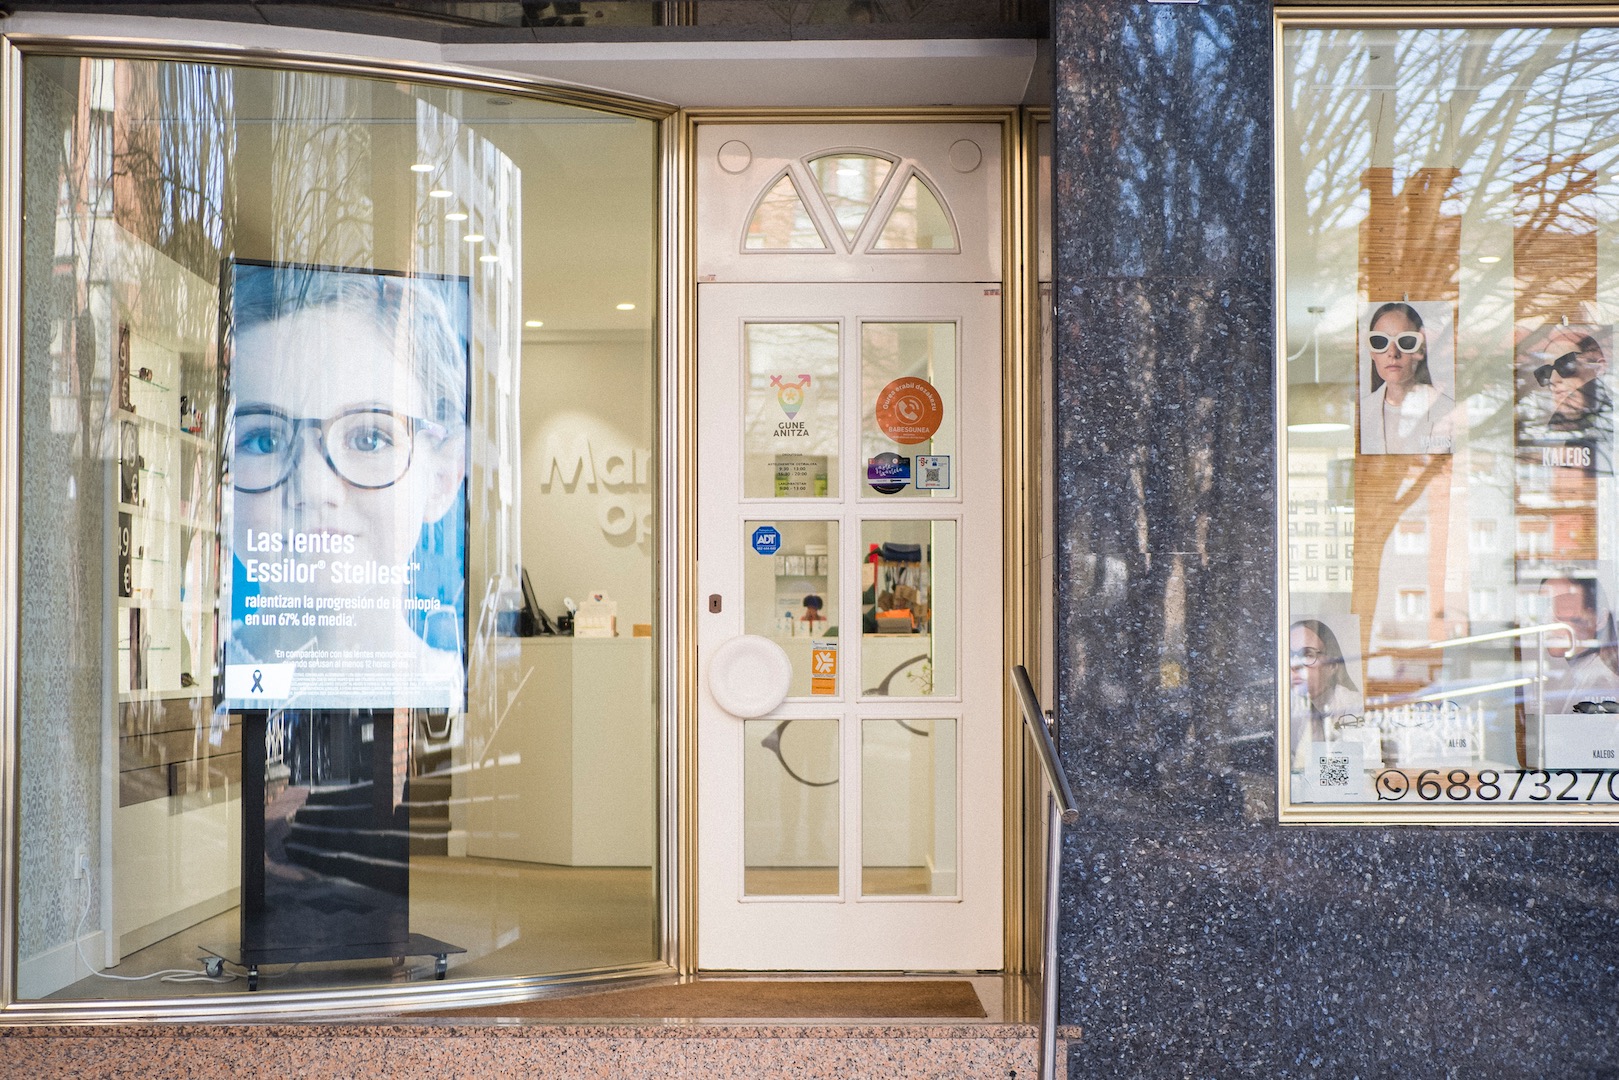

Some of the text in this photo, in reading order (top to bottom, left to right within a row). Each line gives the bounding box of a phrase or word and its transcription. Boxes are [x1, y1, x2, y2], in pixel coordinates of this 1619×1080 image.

[778, 422, 805, 430] GUNE
[773, 429, 810, 437] ANITZA
[1542, 447, 1591, 467] KALEOS
[247, 528, 355, 554] Las lentes
[756, 534, 777, 545] ADT
[245, 594, 301, 609] ralentizan
[303, 594, 314, 609] la
[316, 596, 375, 611] progresión
[376, 596, 390, 609] de
[404, 597, 441, 612] miopía
[245, 613, 260, 626] en
[261, 613, 277, 626] un
[278, 612, 301, 627] 67%
[302, 612, 316, 626] de
[329, 651, 342, 659] con
[1592, 749, 1615, 759] KALEOS
